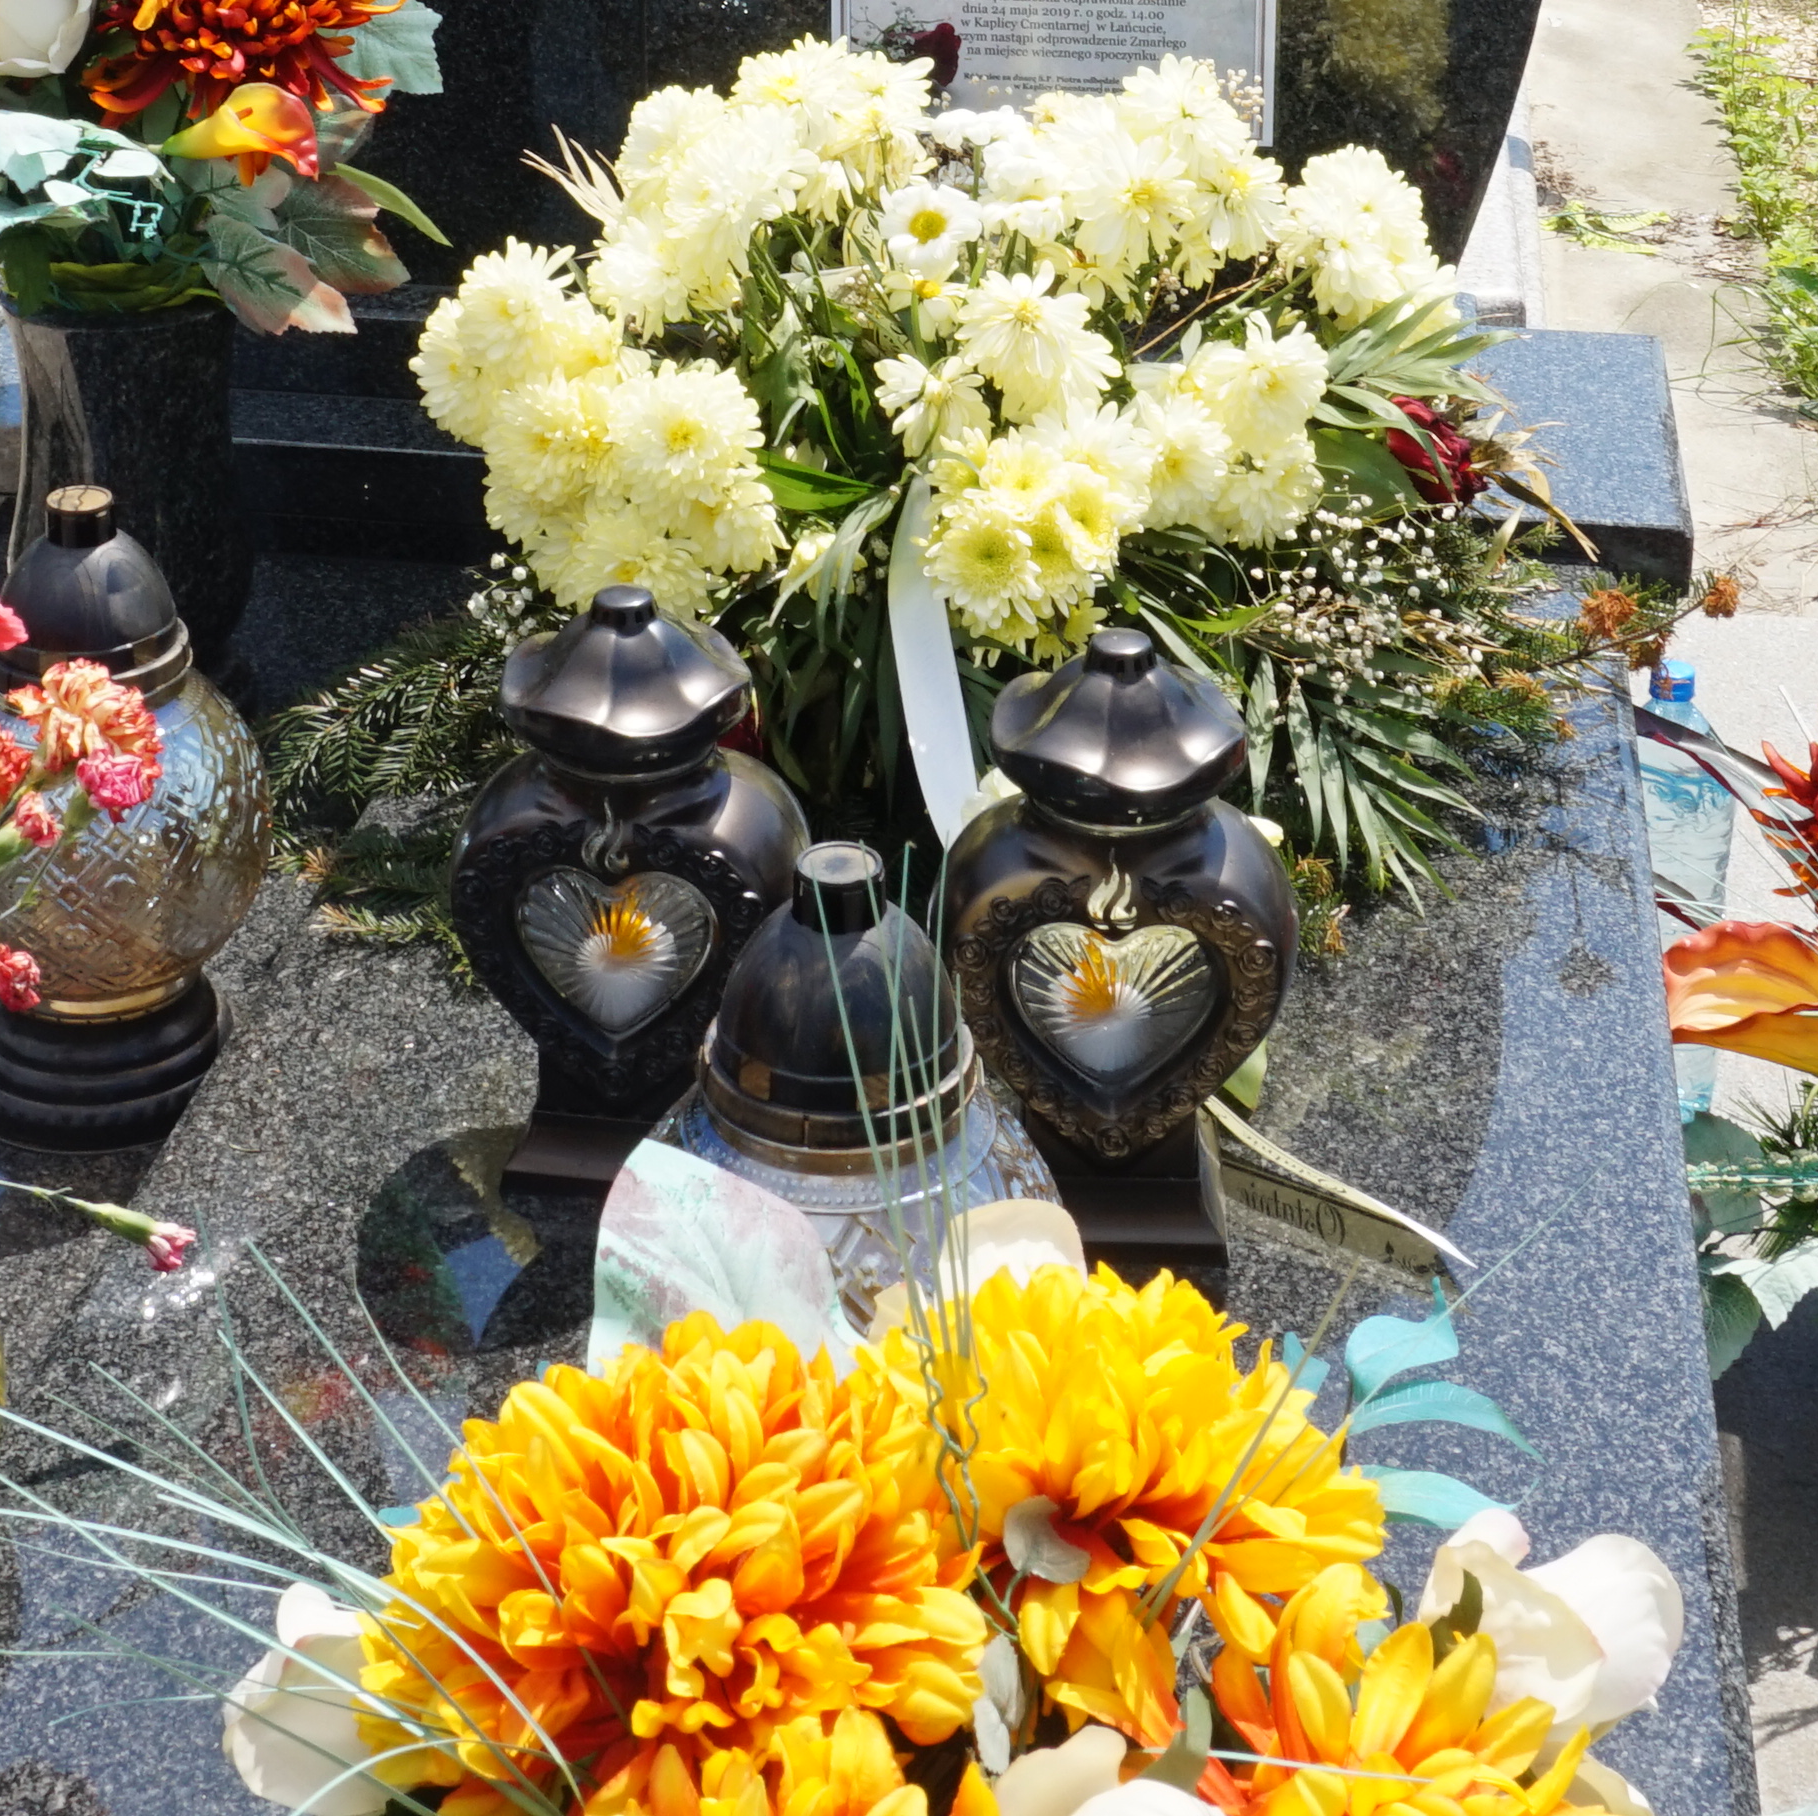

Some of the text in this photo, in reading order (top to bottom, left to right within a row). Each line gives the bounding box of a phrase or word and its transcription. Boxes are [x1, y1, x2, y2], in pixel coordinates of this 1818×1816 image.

[962, 1, 989, 15] dnia
[990, 6, 1007, 17] 24
[1009, 5, 1039, 22] maja
[1041, 7, 1071, 19] 2019
[1096, 7, 1128, 21] godz.
[1131, 10, 1165, 22] 14.00
[961, 16, 1167, 35] w Kaplicy Cmentarnej w Łańcucie,
[990, 32, 1034, 45] nastąpi
[1036, 33, 1128, 47] odprowadzenie
[1129, 34, 1187, 51] Zmarłego
[966, 44, 1160, 64] na miejsce wiecznego spoczynku.
